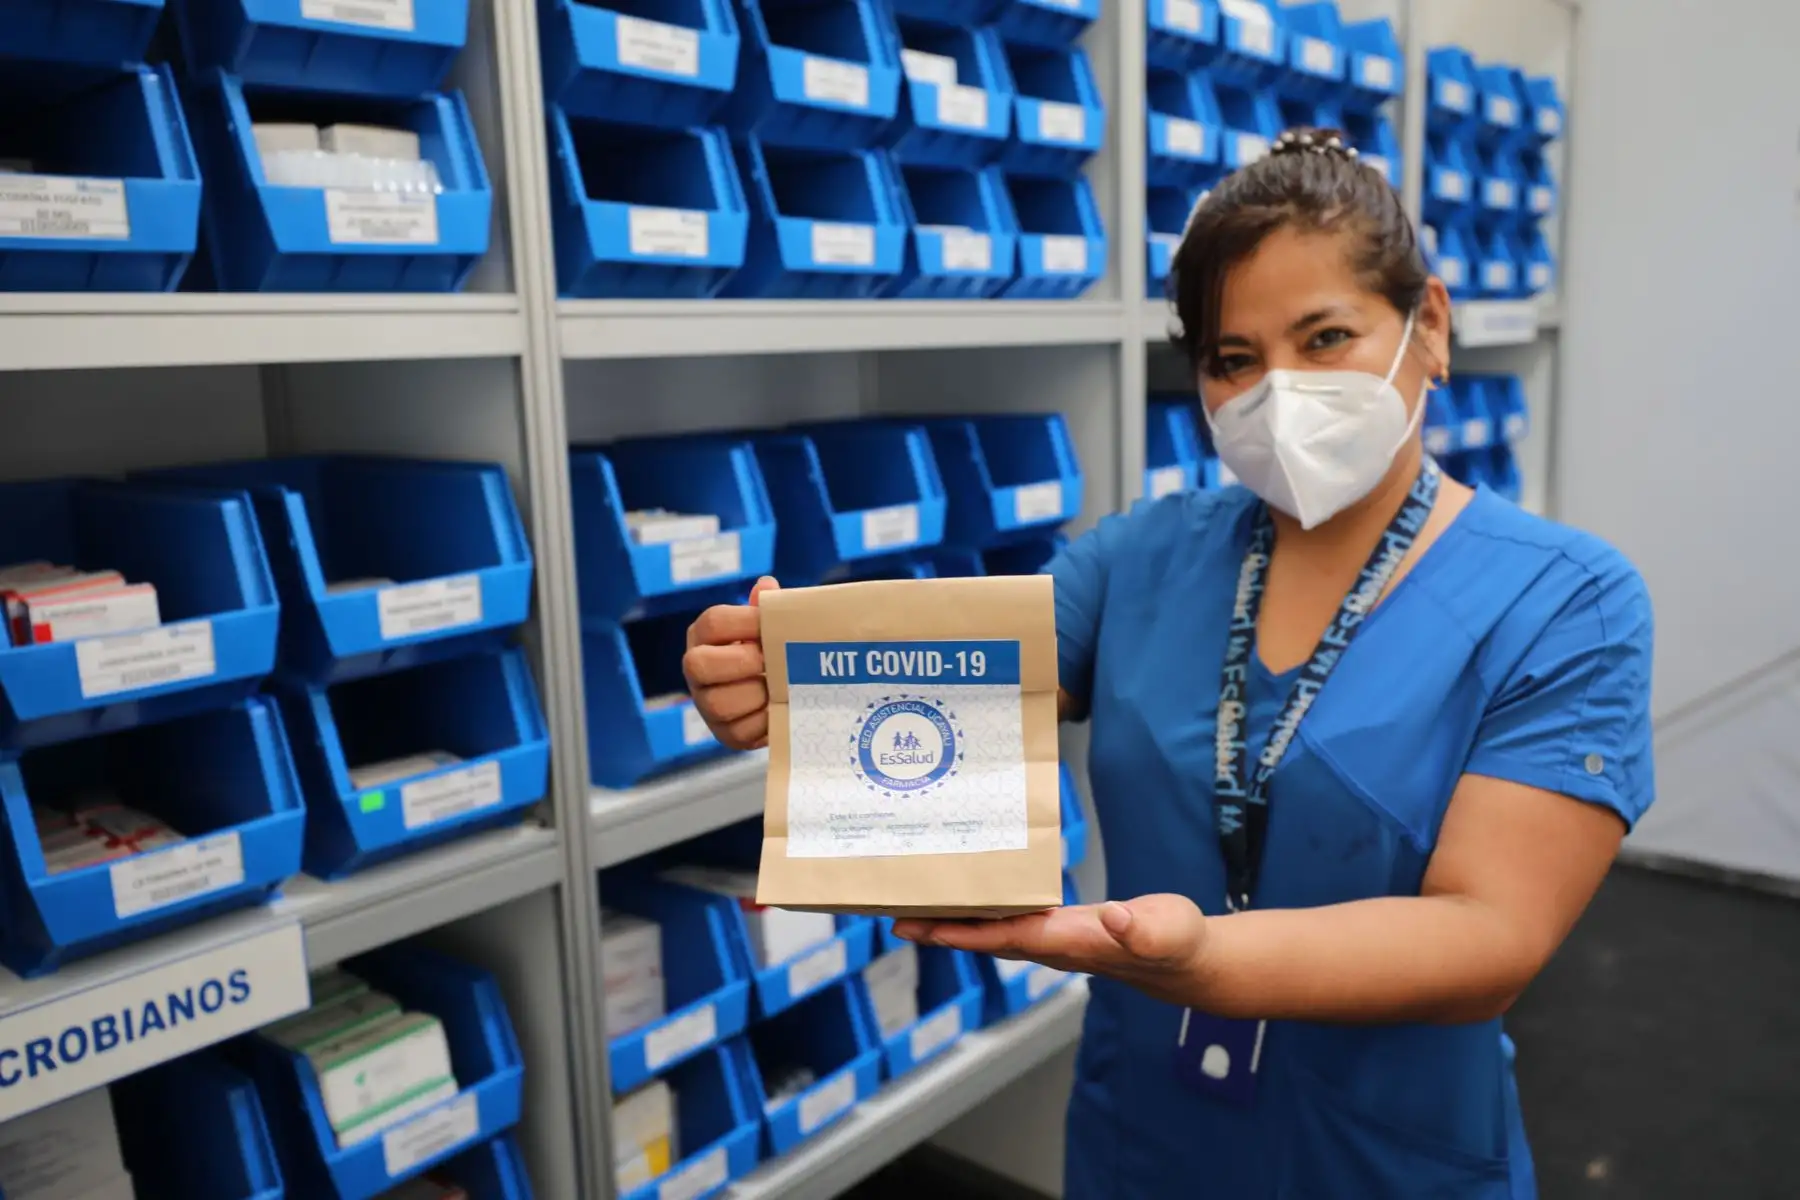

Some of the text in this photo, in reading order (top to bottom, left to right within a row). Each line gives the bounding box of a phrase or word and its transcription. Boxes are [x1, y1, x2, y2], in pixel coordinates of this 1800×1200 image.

[819, 650, 986, 677] KIT COVID-19
[860, 702, 953, 749] RED ASISTENCIAL UCAYALI
[880, 751, 934, 766] EsSalud
[880, 776, 929, 789] FARMACIA
[0, 969, 251, 1087] CROBIANOS
